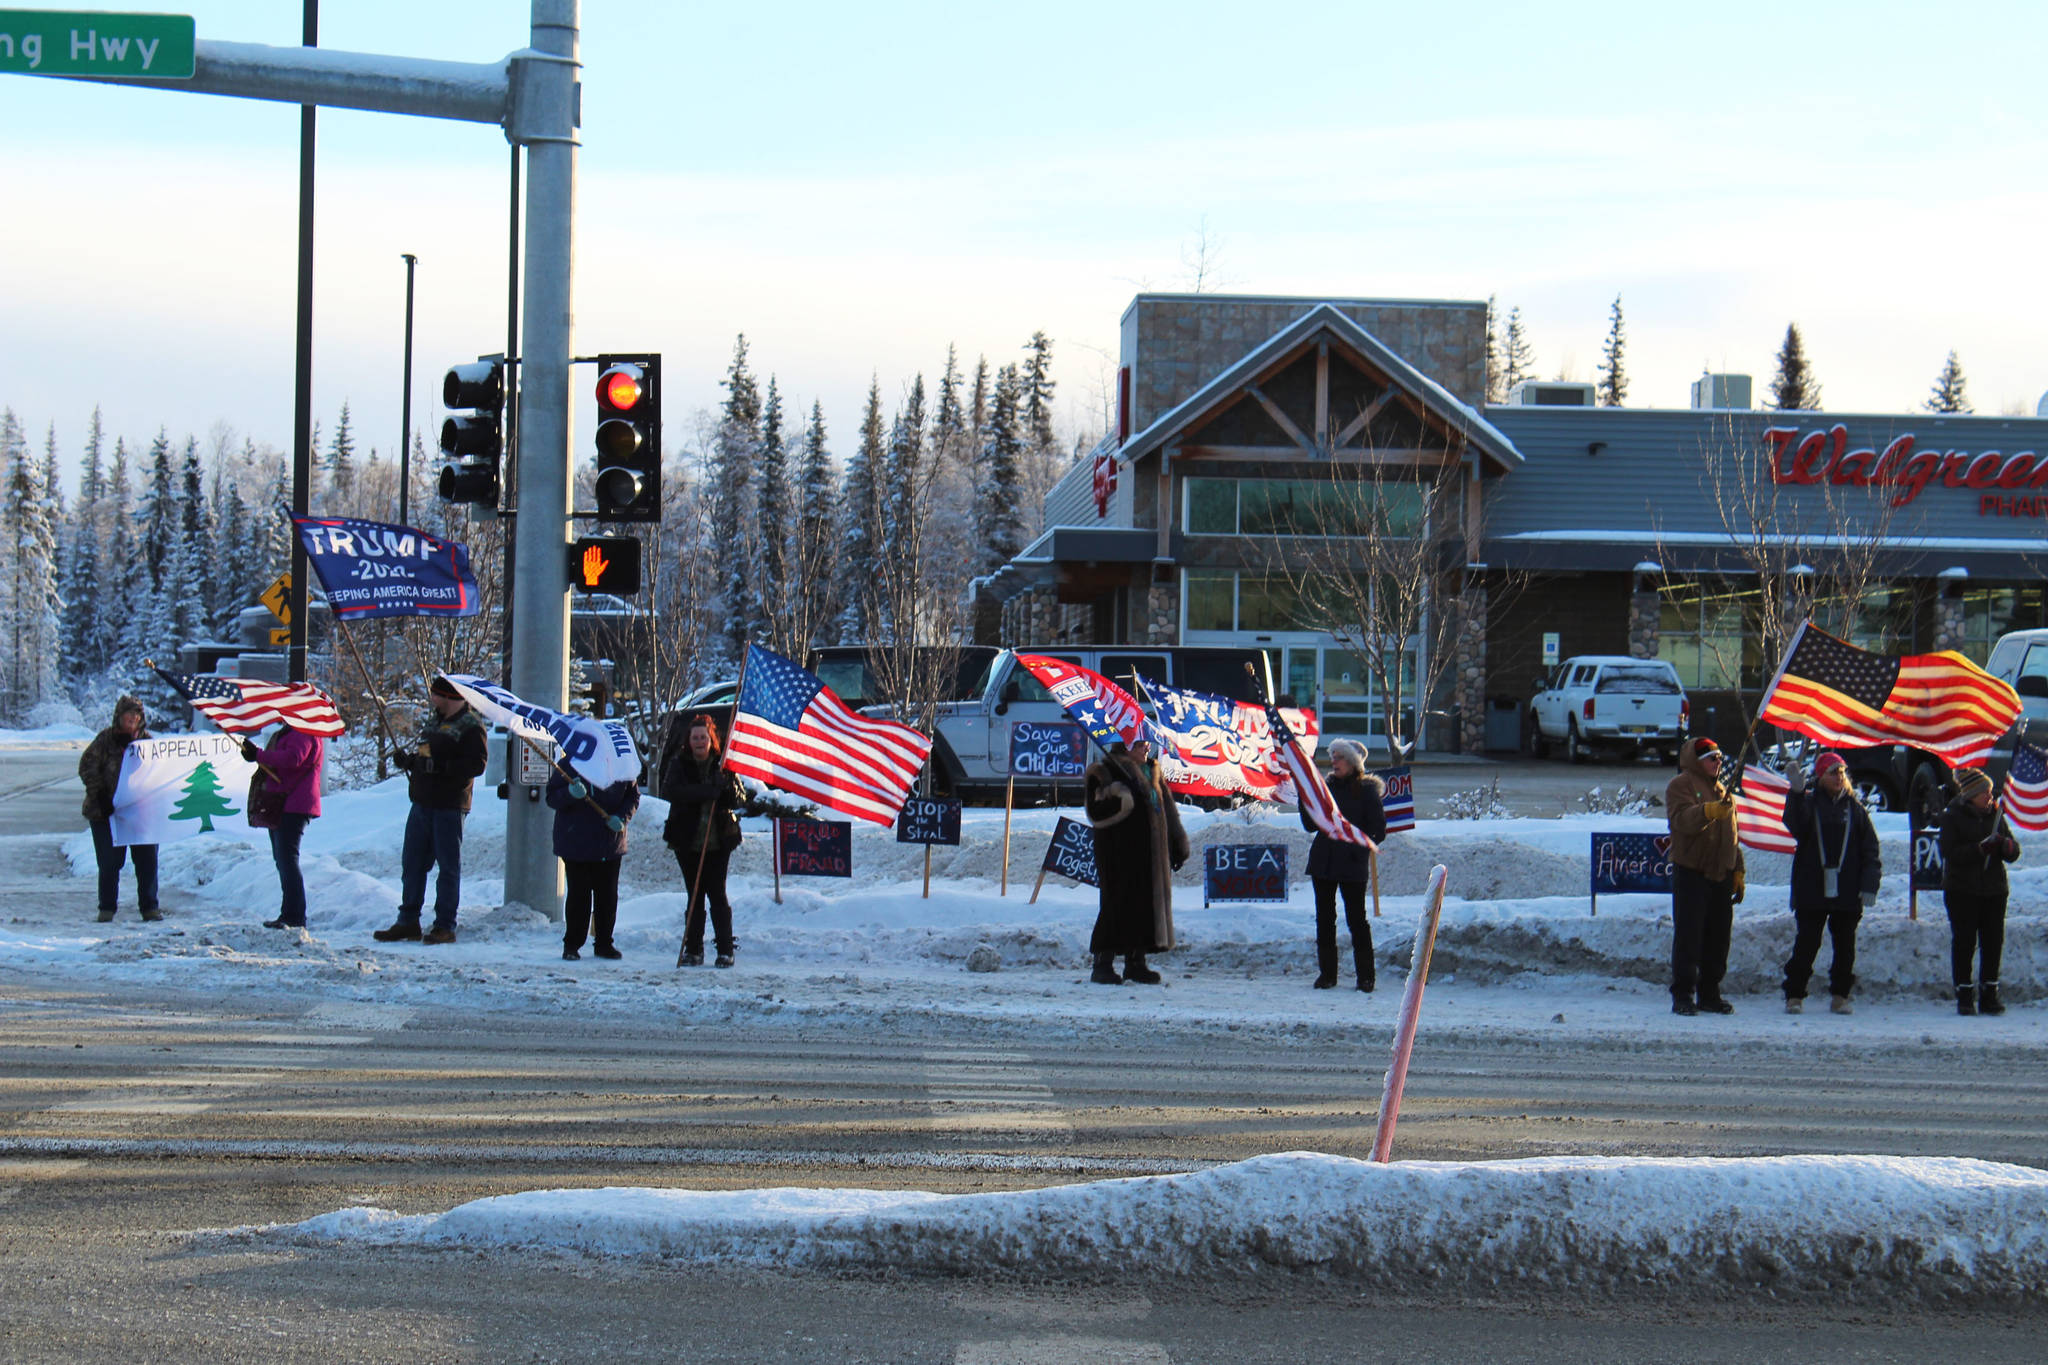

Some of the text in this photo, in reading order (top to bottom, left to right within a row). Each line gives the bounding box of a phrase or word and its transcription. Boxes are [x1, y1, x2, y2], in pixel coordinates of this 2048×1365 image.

[70, 29, 160, 70] Hwy
[373, 586, 419, 599] AMERICA
[1014, 722, 1062, 743] Save
[151, 739, 207, 760] APPEAL
[212, 737, 231, 755] TO
[905, 800, 948, 823] STOP
[1215, 847, 1280, 871] BE A
